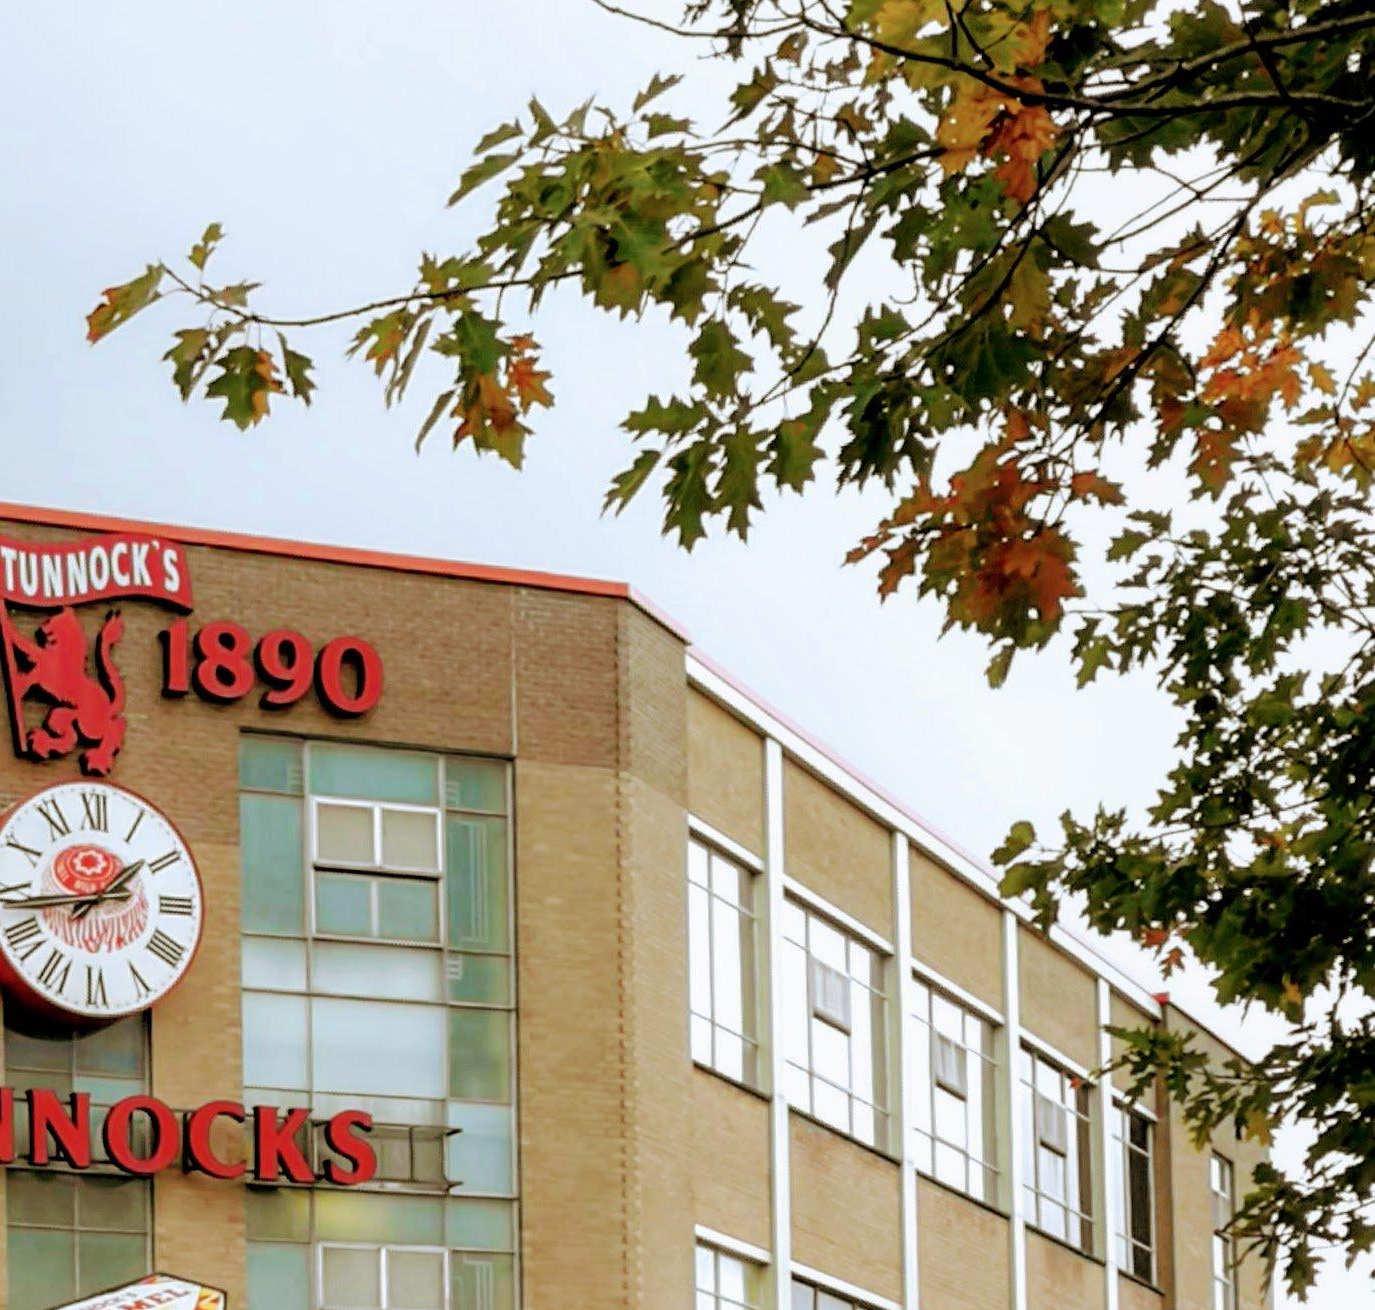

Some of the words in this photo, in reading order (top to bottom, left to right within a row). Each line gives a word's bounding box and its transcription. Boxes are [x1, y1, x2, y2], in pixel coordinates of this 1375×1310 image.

[0, 540, 181, 598] TUNNOCK'S
[159, 618, 384, 717] 1890
[34, 794, 72, 842] XI
[79, 792, 109, 833] XII
[2, 832, 44, 868] X
[147, 849, 183, 875] II
[158, 895, 194, 916] III
[36, 947, 74, 996] VII
[84, 964, 110, 1010] VI
[127, 959, 154, 999] V
